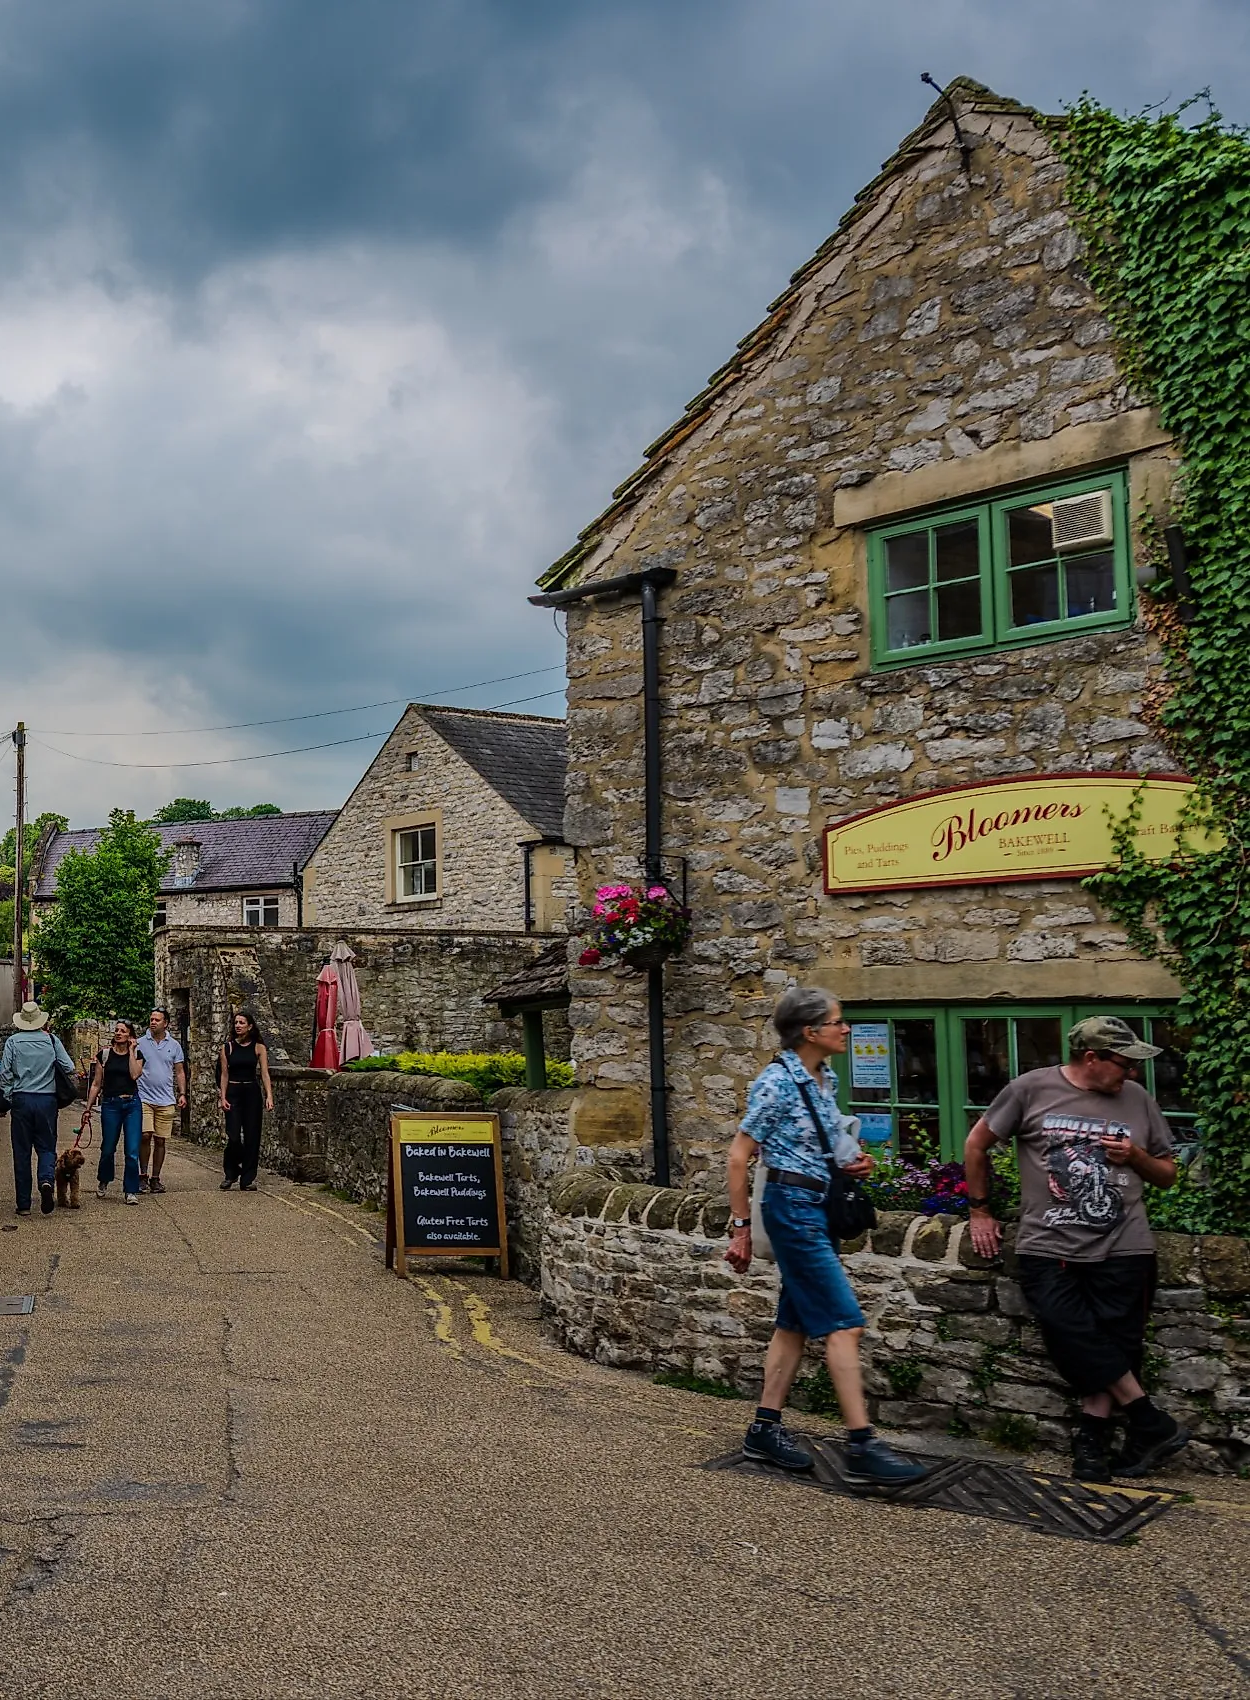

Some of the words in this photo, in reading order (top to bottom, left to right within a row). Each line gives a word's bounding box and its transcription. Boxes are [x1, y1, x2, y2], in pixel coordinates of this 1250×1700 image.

[931, 801, 1091, 861] Bloomers
[1134, 824, 1156, 836] raft
[998, 832, 1071, 849] BAKEWELL
[867, 842, 909, 853] Puddings
[857, 858, 874, 869] and
[875, 858, 900, 868] Tarts
[405, 1145, 436, 1158] Baked
[448, 1145, 491, 1158] Bakewell
[418, 1172, 455, 1182] Bakewell
[455, 1172, 481, 1184] Tarts,
[413, 1186, 450, 1197] Bakewell
[450, 1187, 487, 1200] Puddings
[416, 1215, 445, 1226] Gluten
[446, 1216, 465, 1226] Free
[466, 1216, 488, 1226] Tarts
[426, 1231, 443, 1241] also
[443, 1231, 481, 1241] available.
